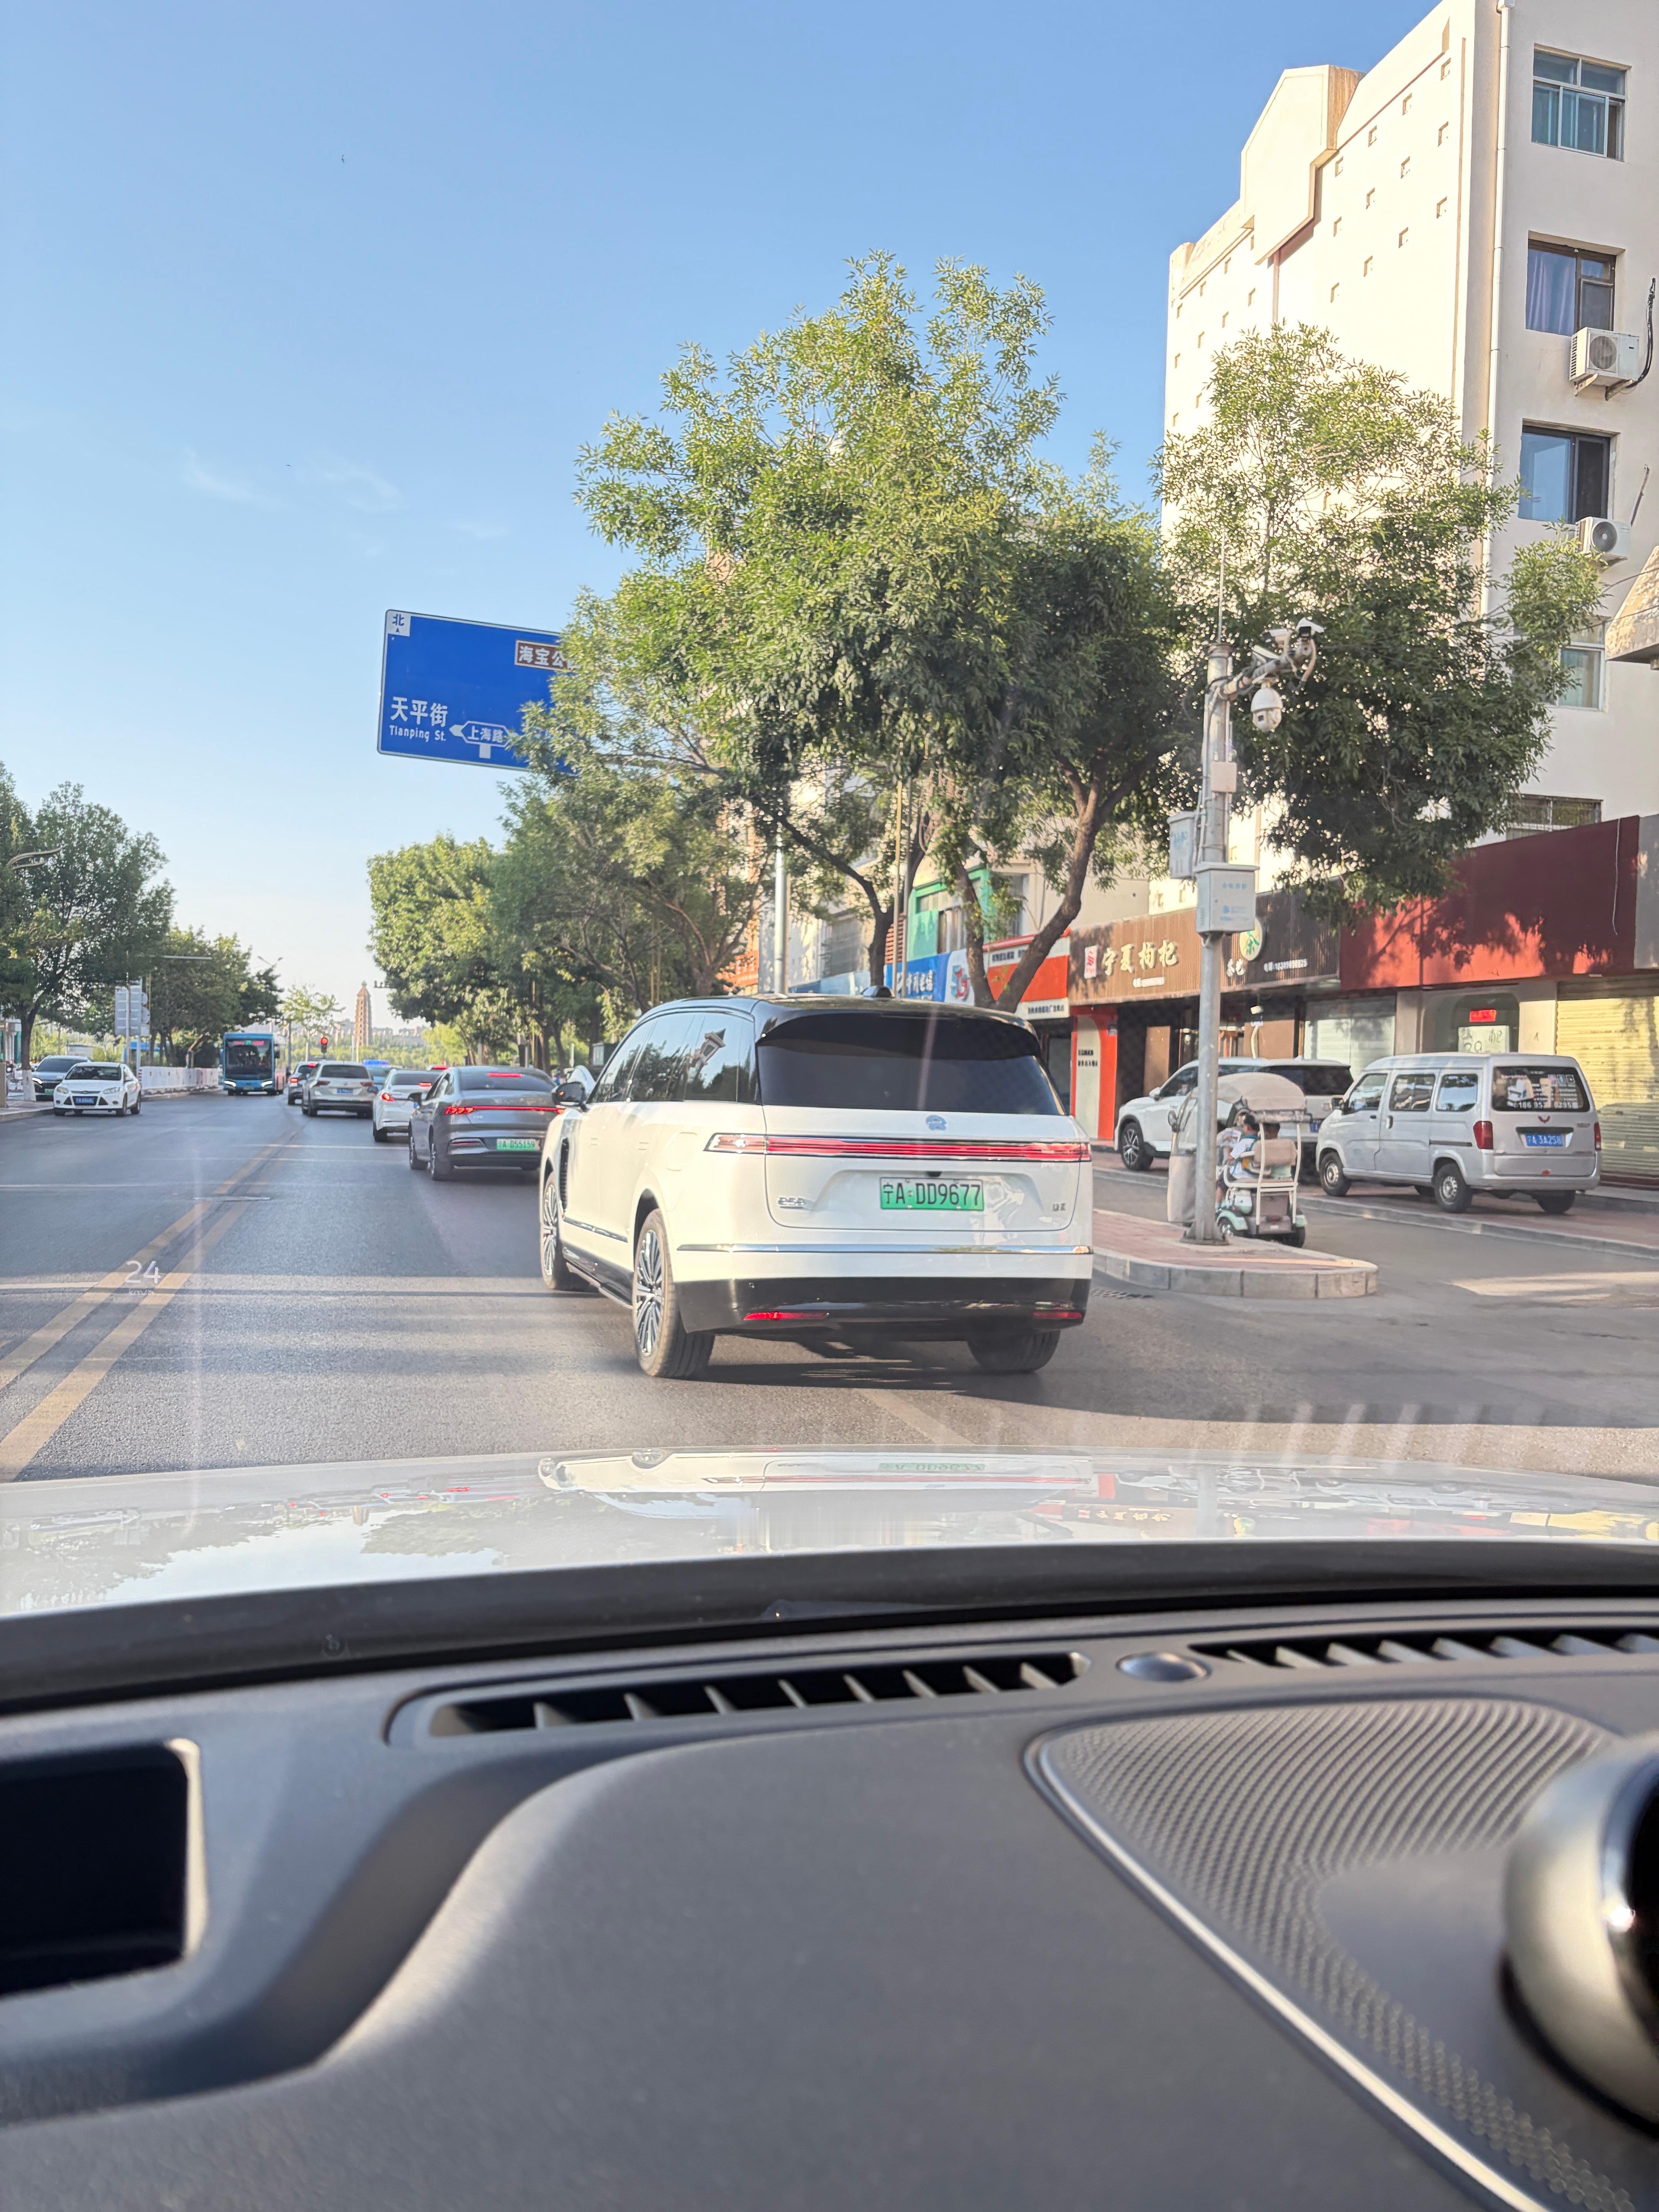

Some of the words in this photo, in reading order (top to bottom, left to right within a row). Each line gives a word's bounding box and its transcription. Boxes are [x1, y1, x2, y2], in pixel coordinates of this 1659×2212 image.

[392, 613, 405, 626] 北
[390, 696, 448, 727] 天平街
[389, 725, 429, 742] Tianping
[434, 730, 447, 741] St.
[467, 725, 503, 743] 上海路
[1102, 939, 1178, 976] 宁夏枸杞
[125, 1260, 161, 1284] 24
